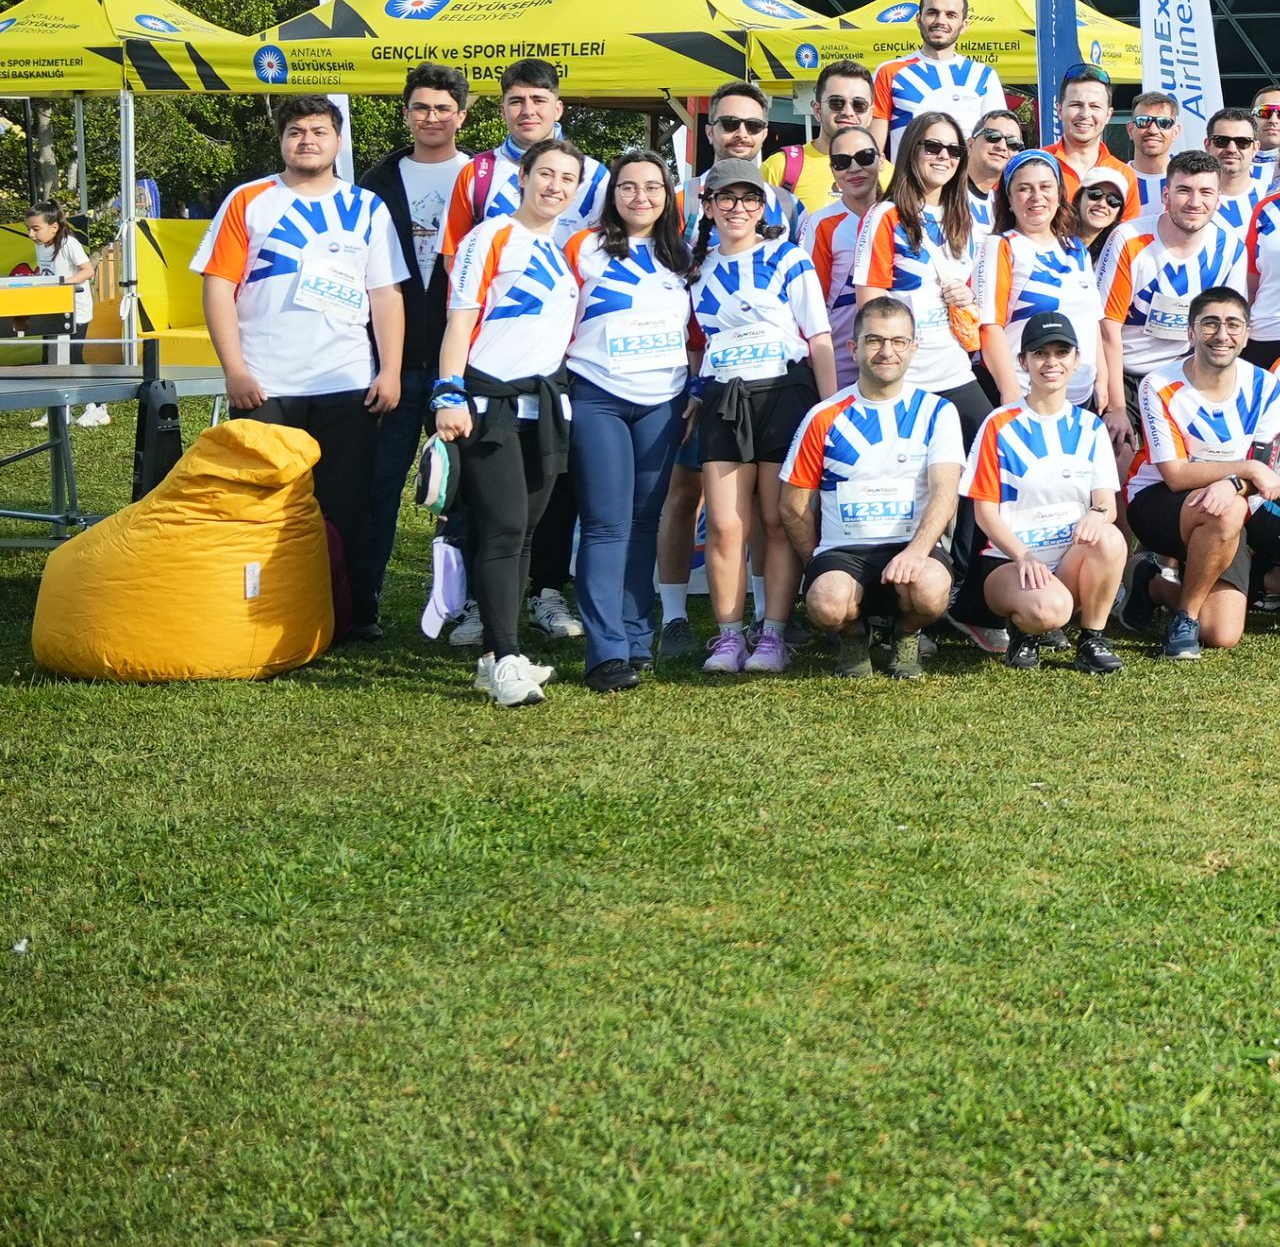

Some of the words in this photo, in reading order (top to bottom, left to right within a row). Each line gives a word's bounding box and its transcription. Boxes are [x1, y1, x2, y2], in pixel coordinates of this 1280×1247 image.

[290, 48, 333, 58] ANTALYA
[371, 43, 438, 62] GENÇLİK
[441, 49, 458, 59] ve
[462, 45, 506, 59] SPOR
[510, 39, 607, 58] HİZMETLERİ
[873, 40, 916, 53] GENÇLİK
[961, 40, 1020, 51] HİZMETLERİ
[7, 59, 31, 67] SPOR
[33, 56, 83, 67] HİZMETLERİ
[965, 52, 998, 63] ANLIĞI
[291, 59, 356, 73] BÜYÜKŞEHİR
[473, 61, 568, 82] BAŞĞI
[291, 73, 342, 85] BELEDİYESİ
[306, 276, 362, 301] 12252
[1152, 311, 1188, 325] 123
[612, 332, 680, 352] 12335
[713, 342, 783, 362] 12275
[843, 502, 912, 517] 12310
